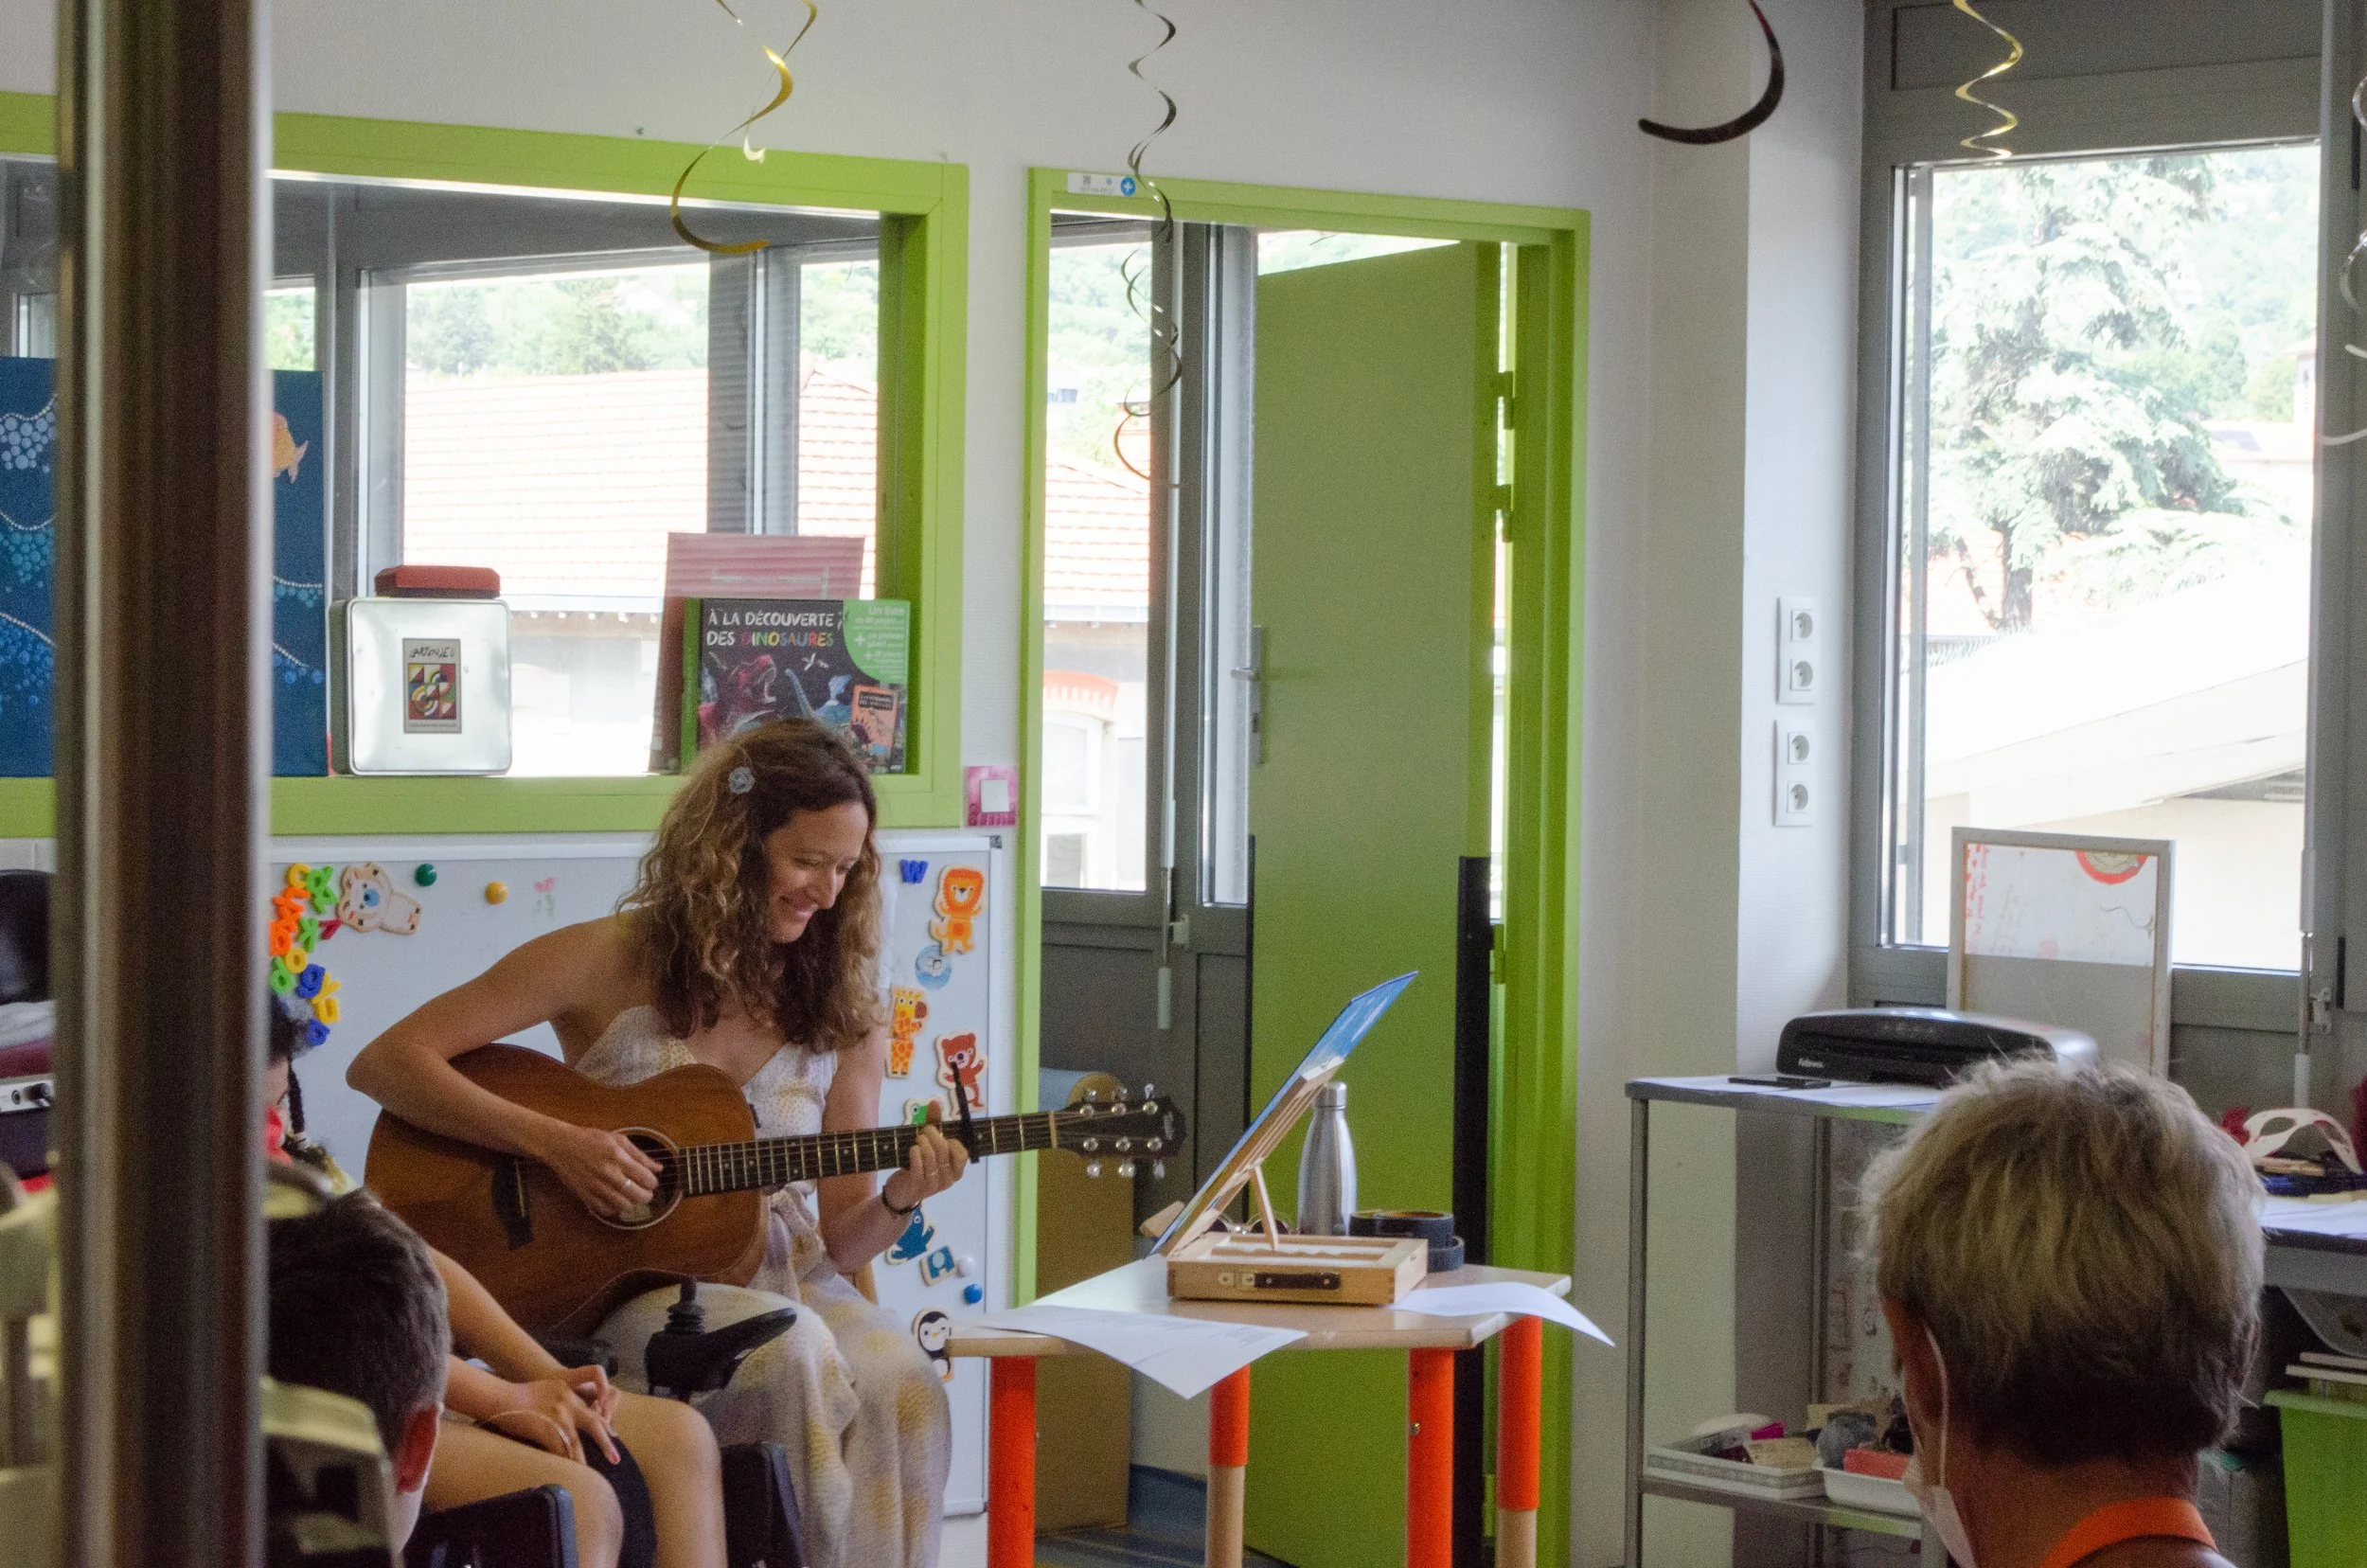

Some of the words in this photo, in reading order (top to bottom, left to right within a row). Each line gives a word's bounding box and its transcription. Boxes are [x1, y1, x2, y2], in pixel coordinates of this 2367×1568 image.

[708, 609, 718, 625] À
[723, 612, 739, 625] LA
[745, 611, 833, 626] DÉCOUVERTE
[706, 631, 735, 646] DES
[740, 630, 833, 647] DINOSAURES
